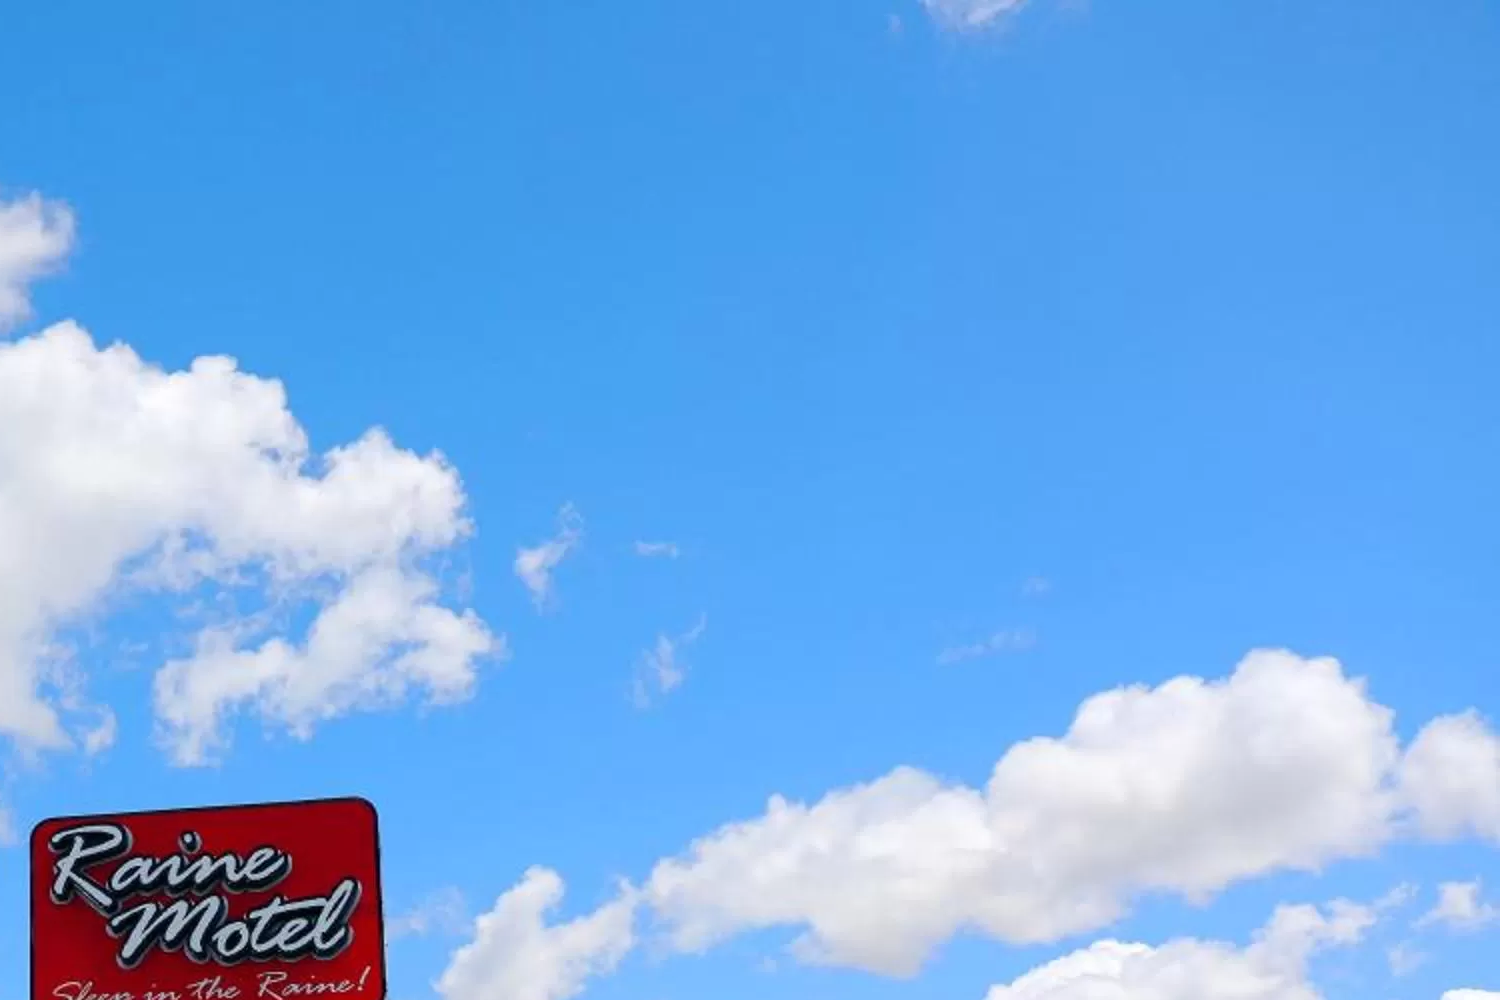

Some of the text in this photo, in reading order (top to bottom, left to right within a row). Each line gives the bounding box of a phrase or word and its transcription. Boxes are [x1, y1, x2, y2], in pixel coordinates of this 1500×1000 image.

[50, 824, 291, 914] Raine
[108, 879, 360, 966] Motel
[187, 976, 241, 1000] the
[256, 966, 371, 1000] Raine!
